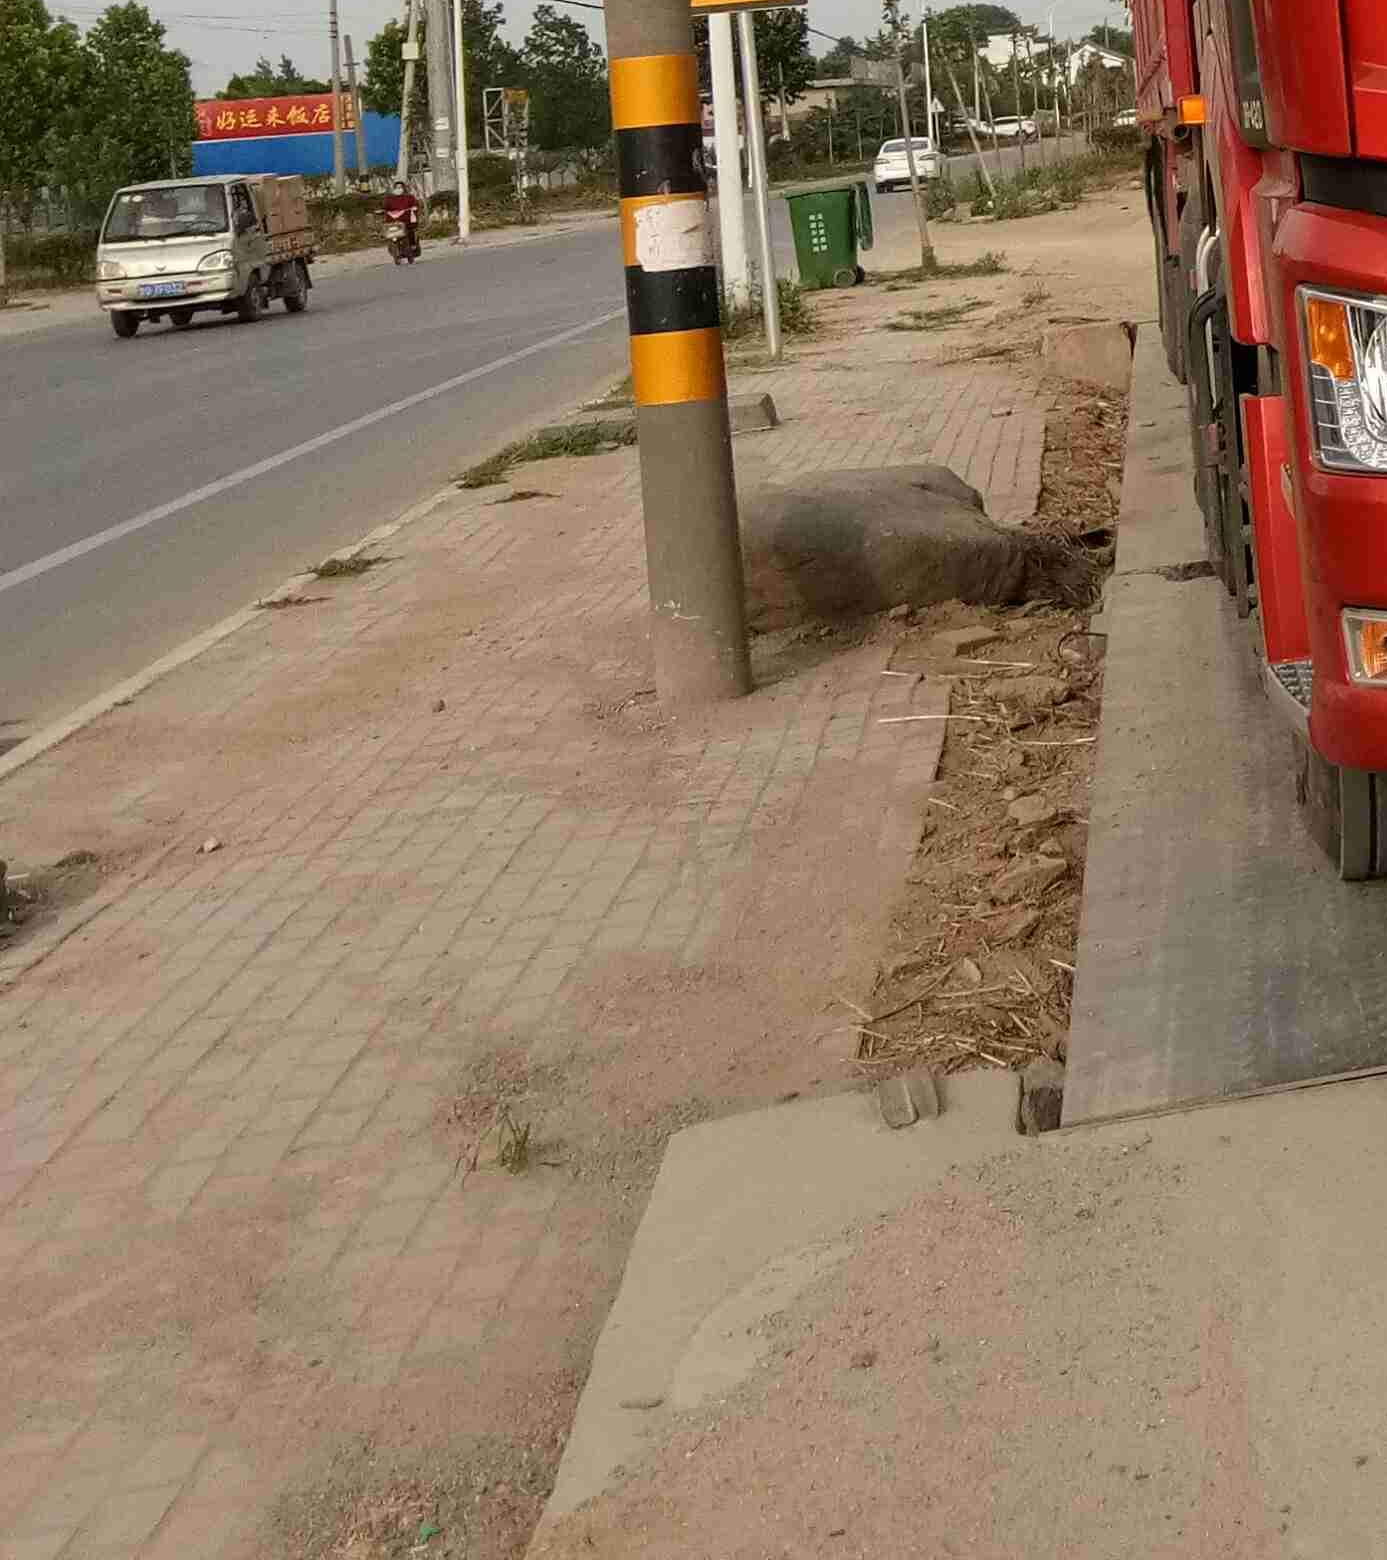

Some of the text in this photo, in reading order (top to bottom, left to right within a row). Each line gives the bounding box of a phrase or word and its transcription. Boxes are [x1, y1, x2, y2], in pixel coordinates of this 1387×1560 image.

[216, 103, 332, 130] 好运来饭店
